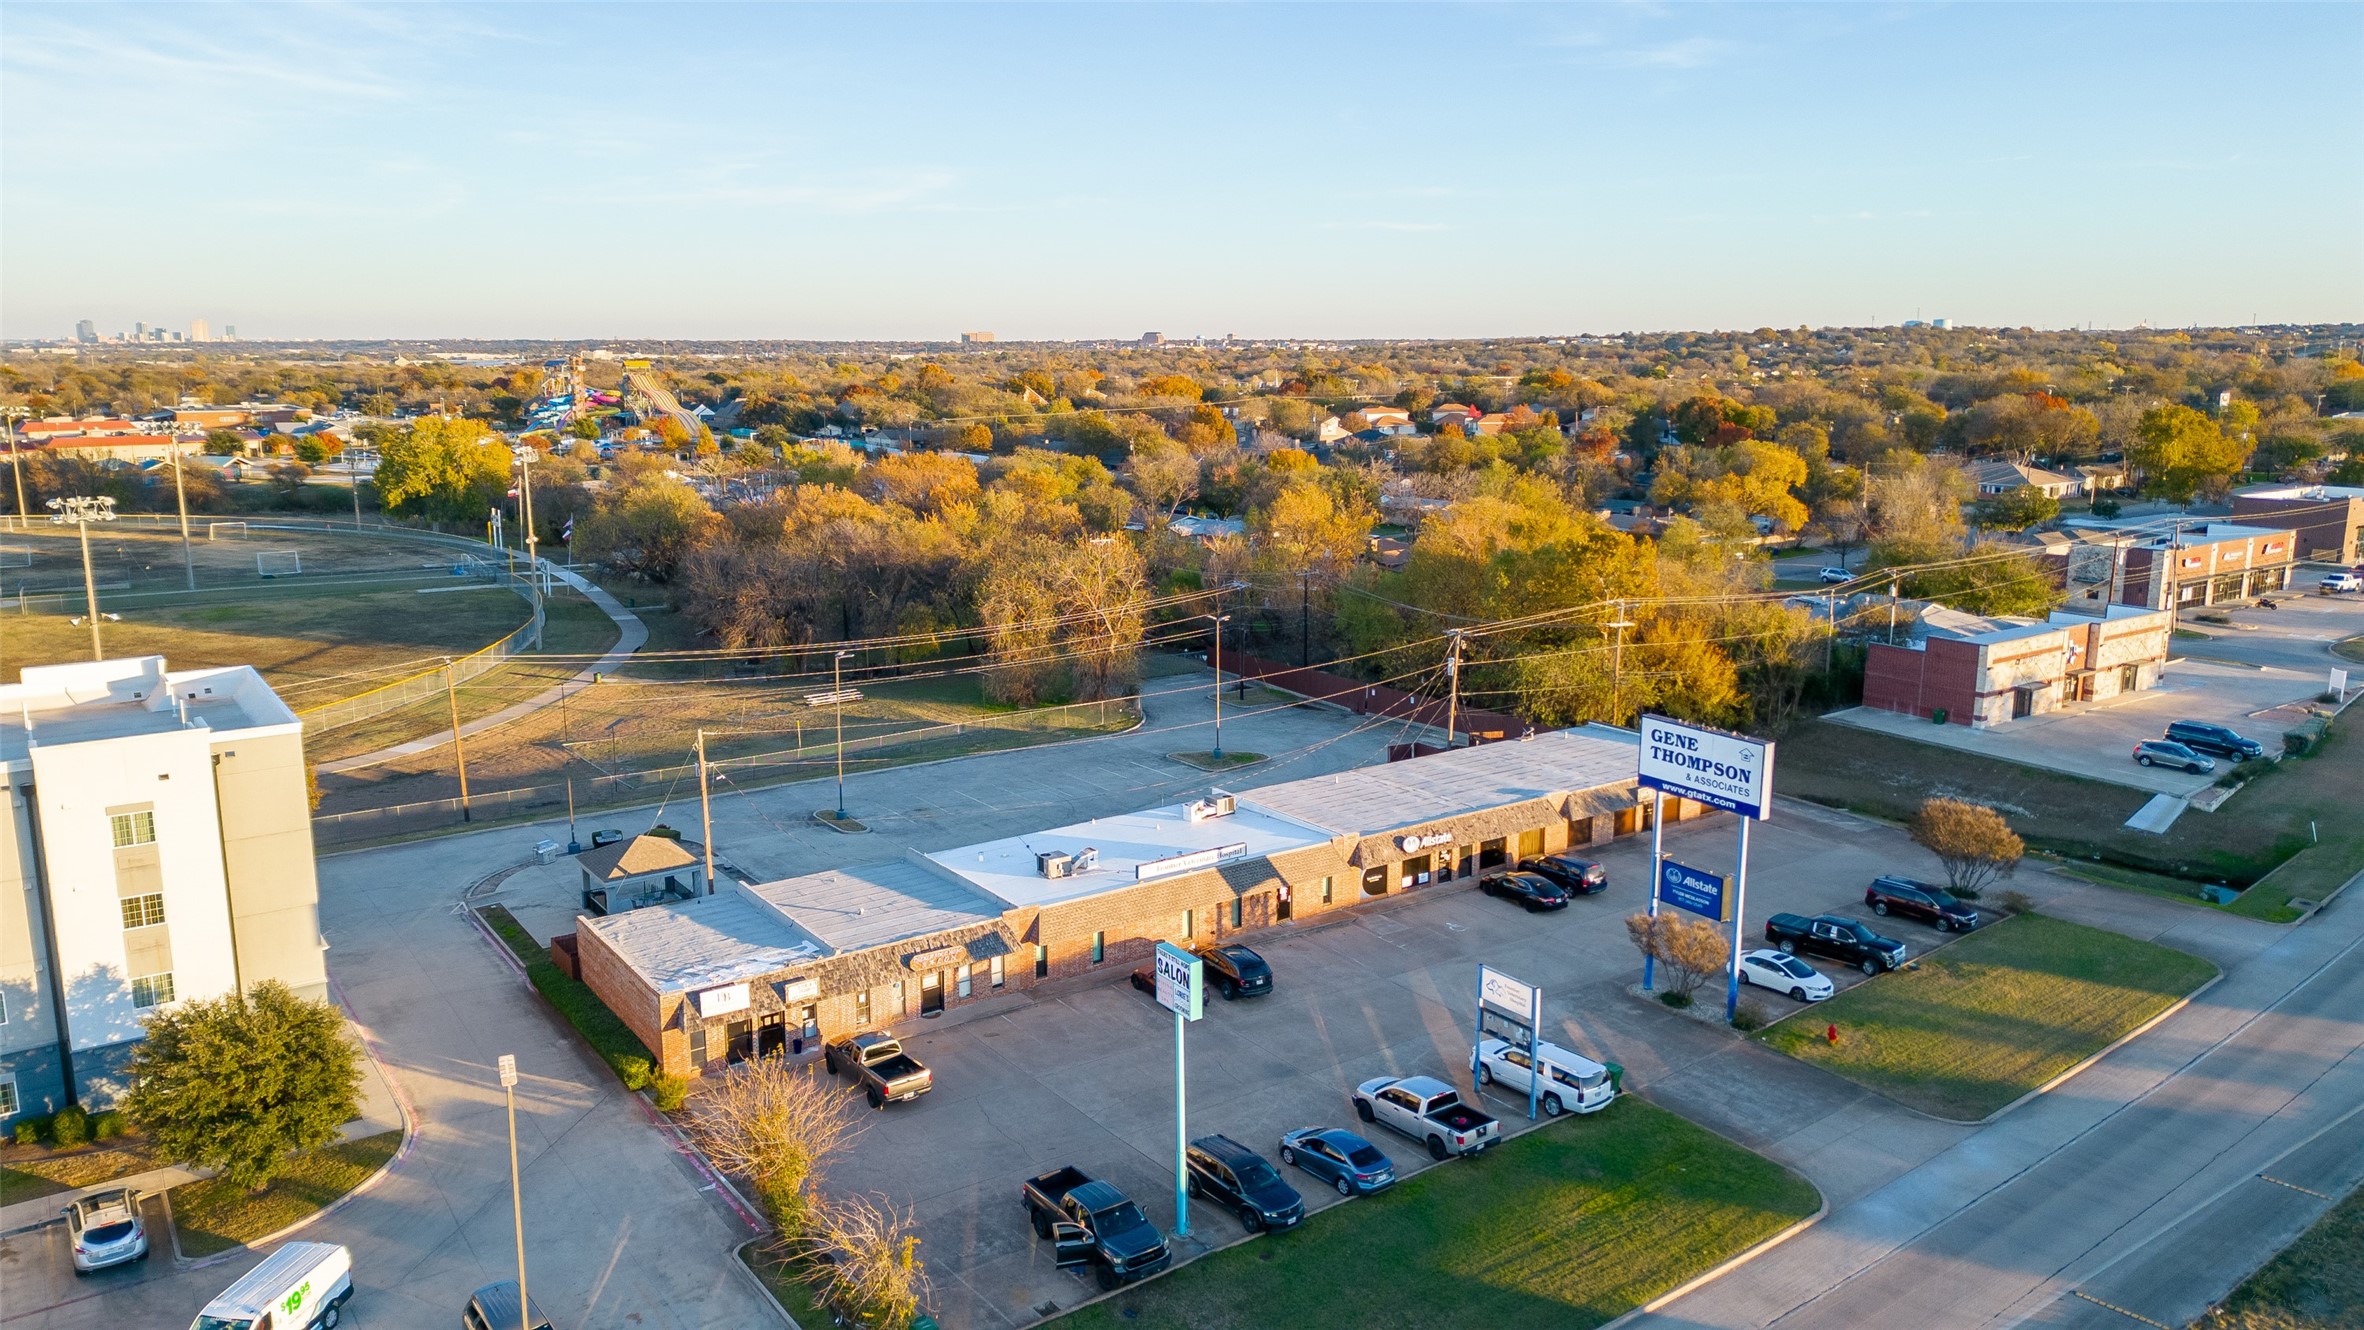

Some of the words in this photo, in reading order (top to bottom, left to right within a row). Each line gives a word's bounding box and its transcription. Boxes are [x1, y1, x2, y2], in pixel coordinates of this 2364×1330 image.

[1651, 728, 1699, 752] GENE
[1650, 746, 1751, 784] THOMPSON
[1662, 782, 1736, 809] www.gtatx.com
[1685, 773, 1692, 781] &
[1694, 775, 1750, 797] ASSOCIATES
[1420, 833, 1452, 848] Allstate
[1217, 848, 1243, 860] Hospital
[1683, 876, 1718, 895] Allstate
[1157, 957, 1190, 989] SALON
